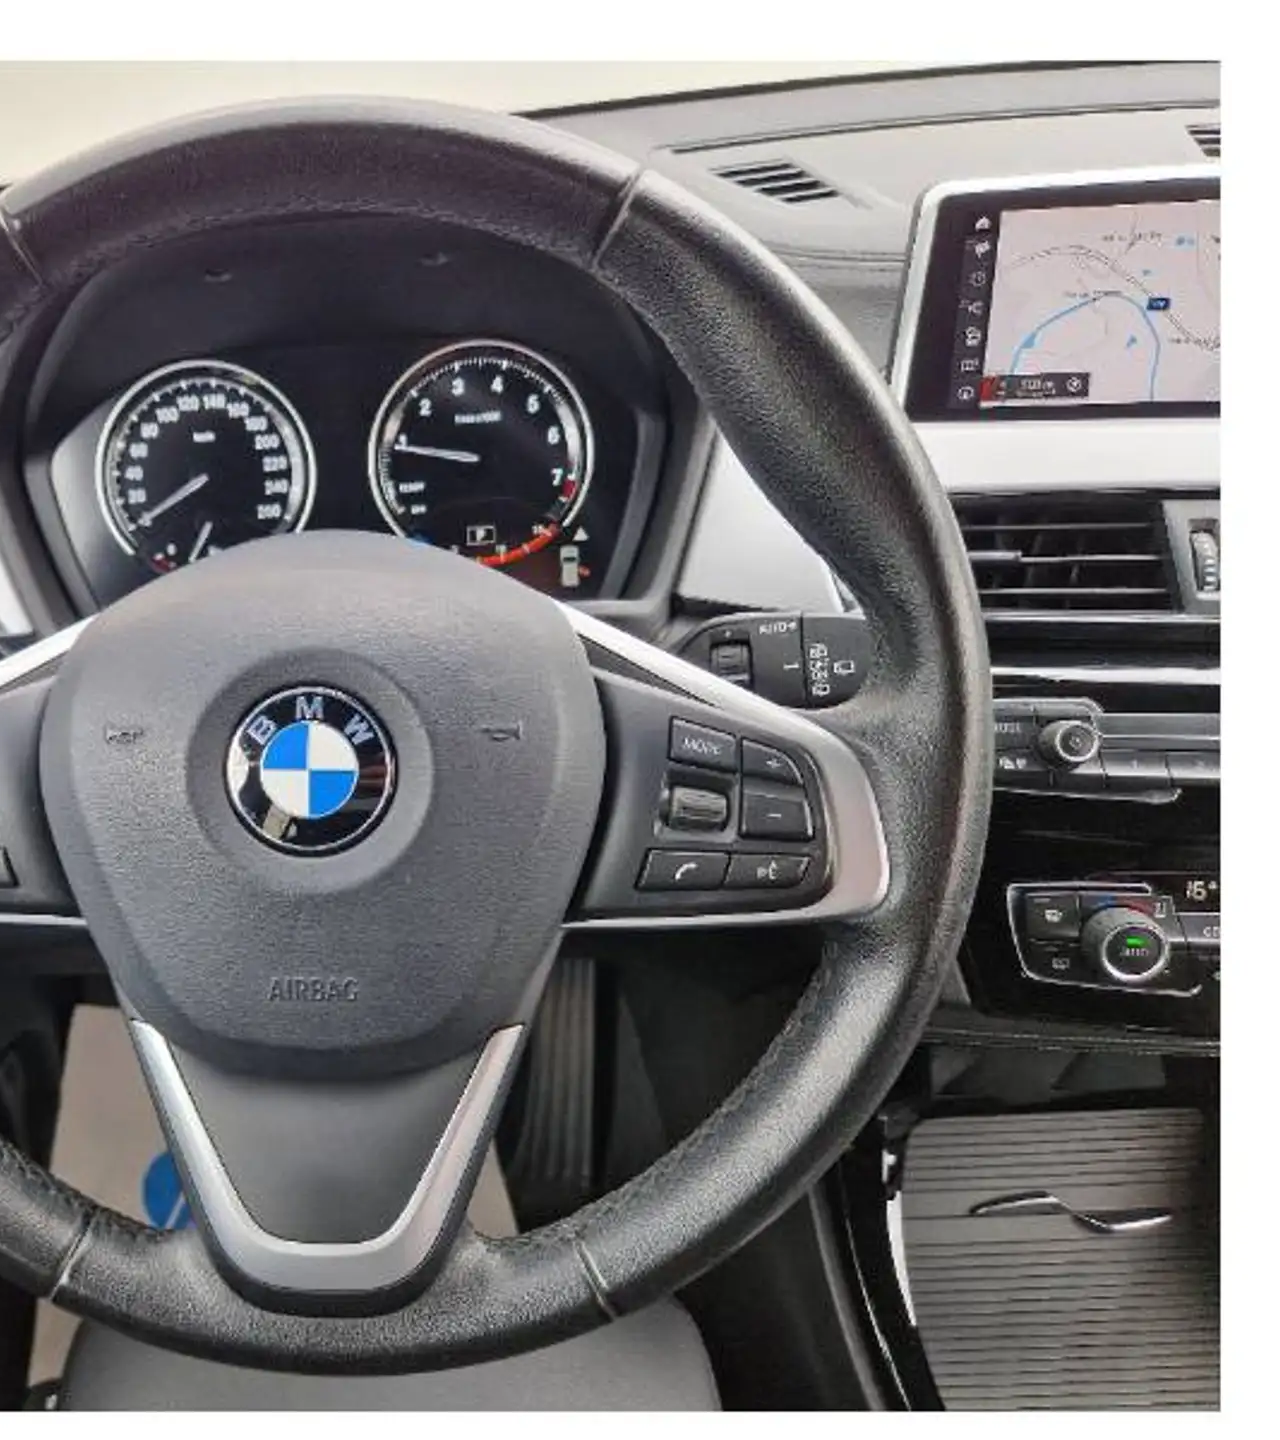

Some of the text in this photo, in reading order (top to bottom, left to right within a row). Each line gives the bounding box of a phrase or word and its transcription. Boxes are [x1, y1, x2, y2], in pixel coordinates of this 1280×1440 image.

[451, 377, 465, 396] 3
[491, 374, 503, 393] 4
[177, 394, 200, 411] 120
[203, 393, 226, 409] 140
[419, 398, 432, 416] 2
[527, 394, 540, 414] 5
[156, 406, 179, 424] 100
[255, 434, 280, 450] 200
[547, 425, 560, 444] 6
[262, 456, 288, 472] 220
[551, 468, 563, 486] 7
[265, 479, 288, 495] 240
[246, 695, 375, 746] BMW
[266, 976, 359, 1001] AIRBAG
